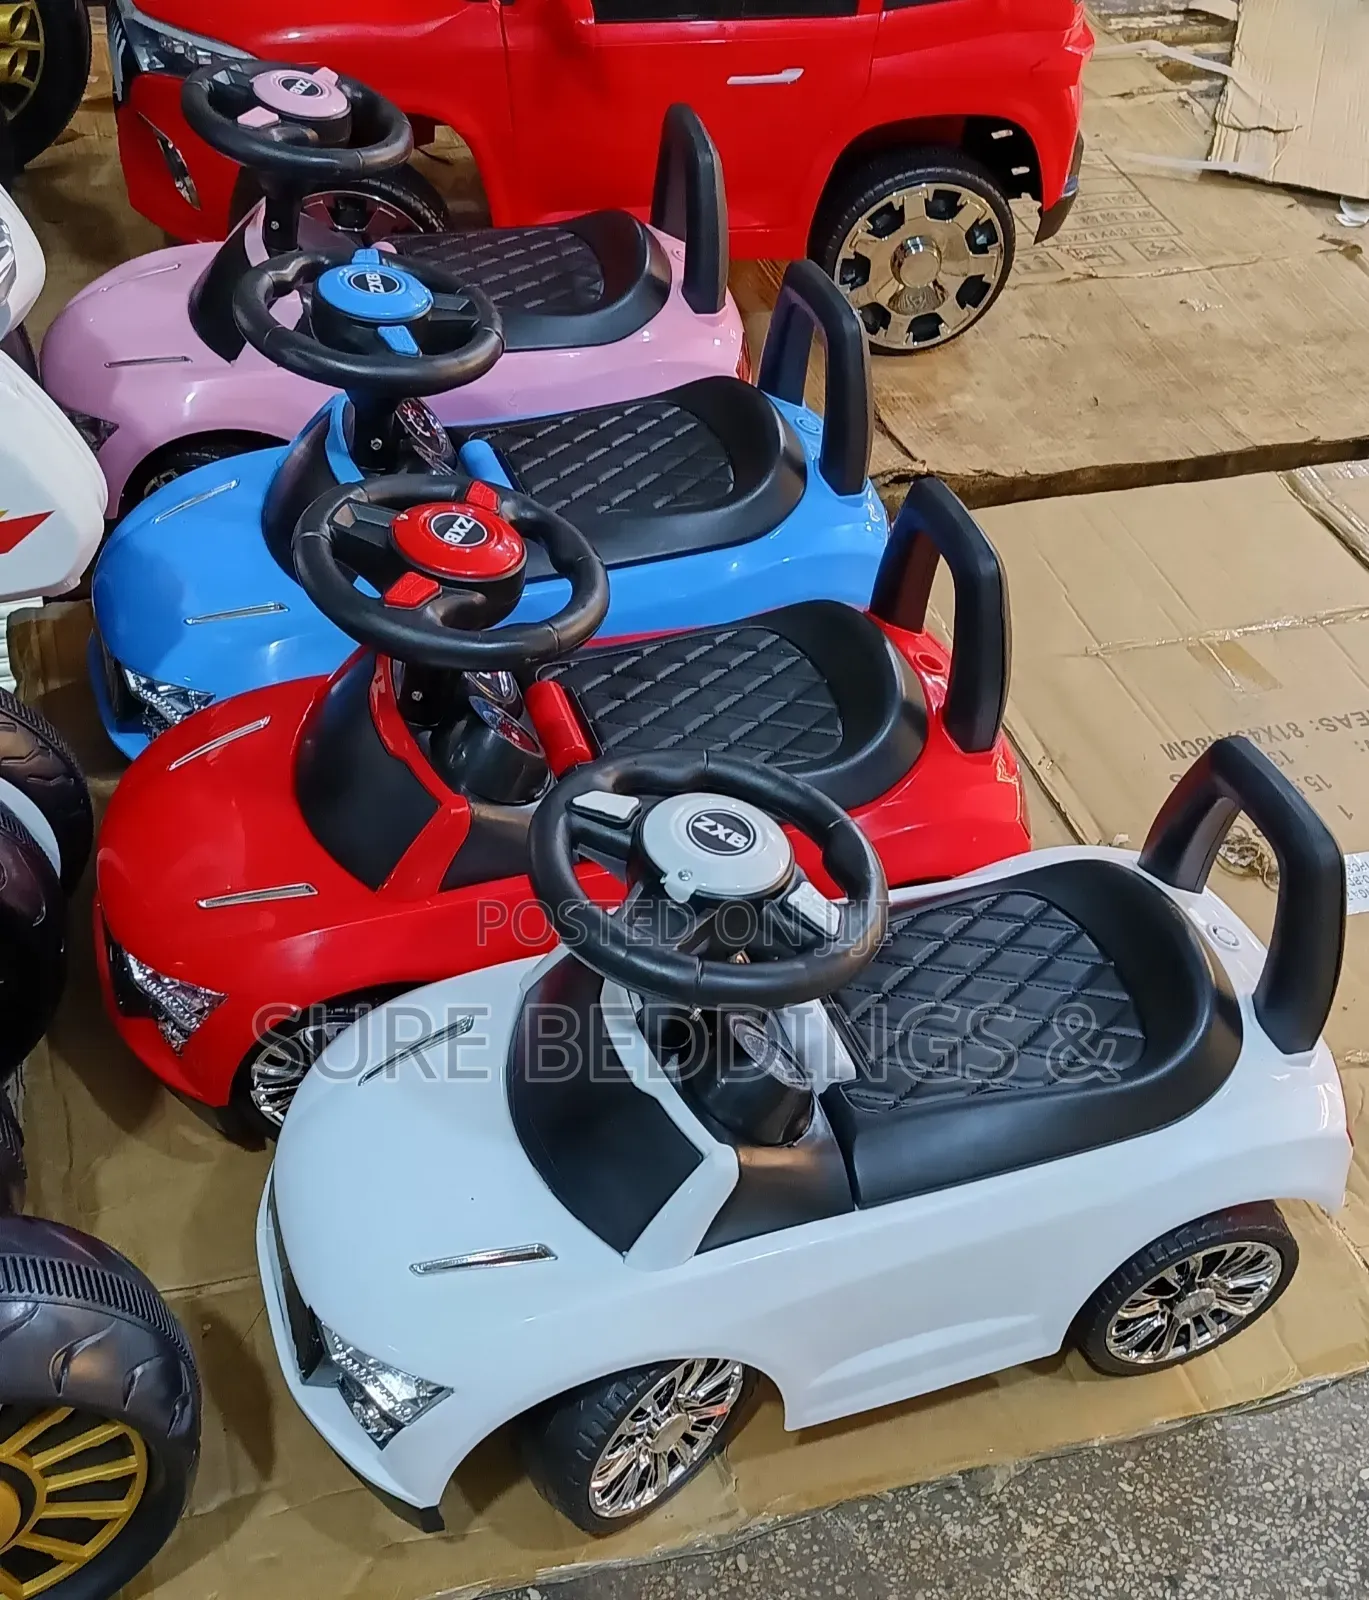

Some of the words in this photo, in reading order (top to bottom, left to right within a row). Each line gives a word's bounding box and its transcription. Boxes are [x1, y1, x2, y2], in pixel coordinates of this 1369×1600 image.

[365, 273, 385, 293] ZXB
[443, 516, 476, 543] ZXB
[1309, 709, 1369, 733] EAS:
[692, 816, 748, 848] ZXB
